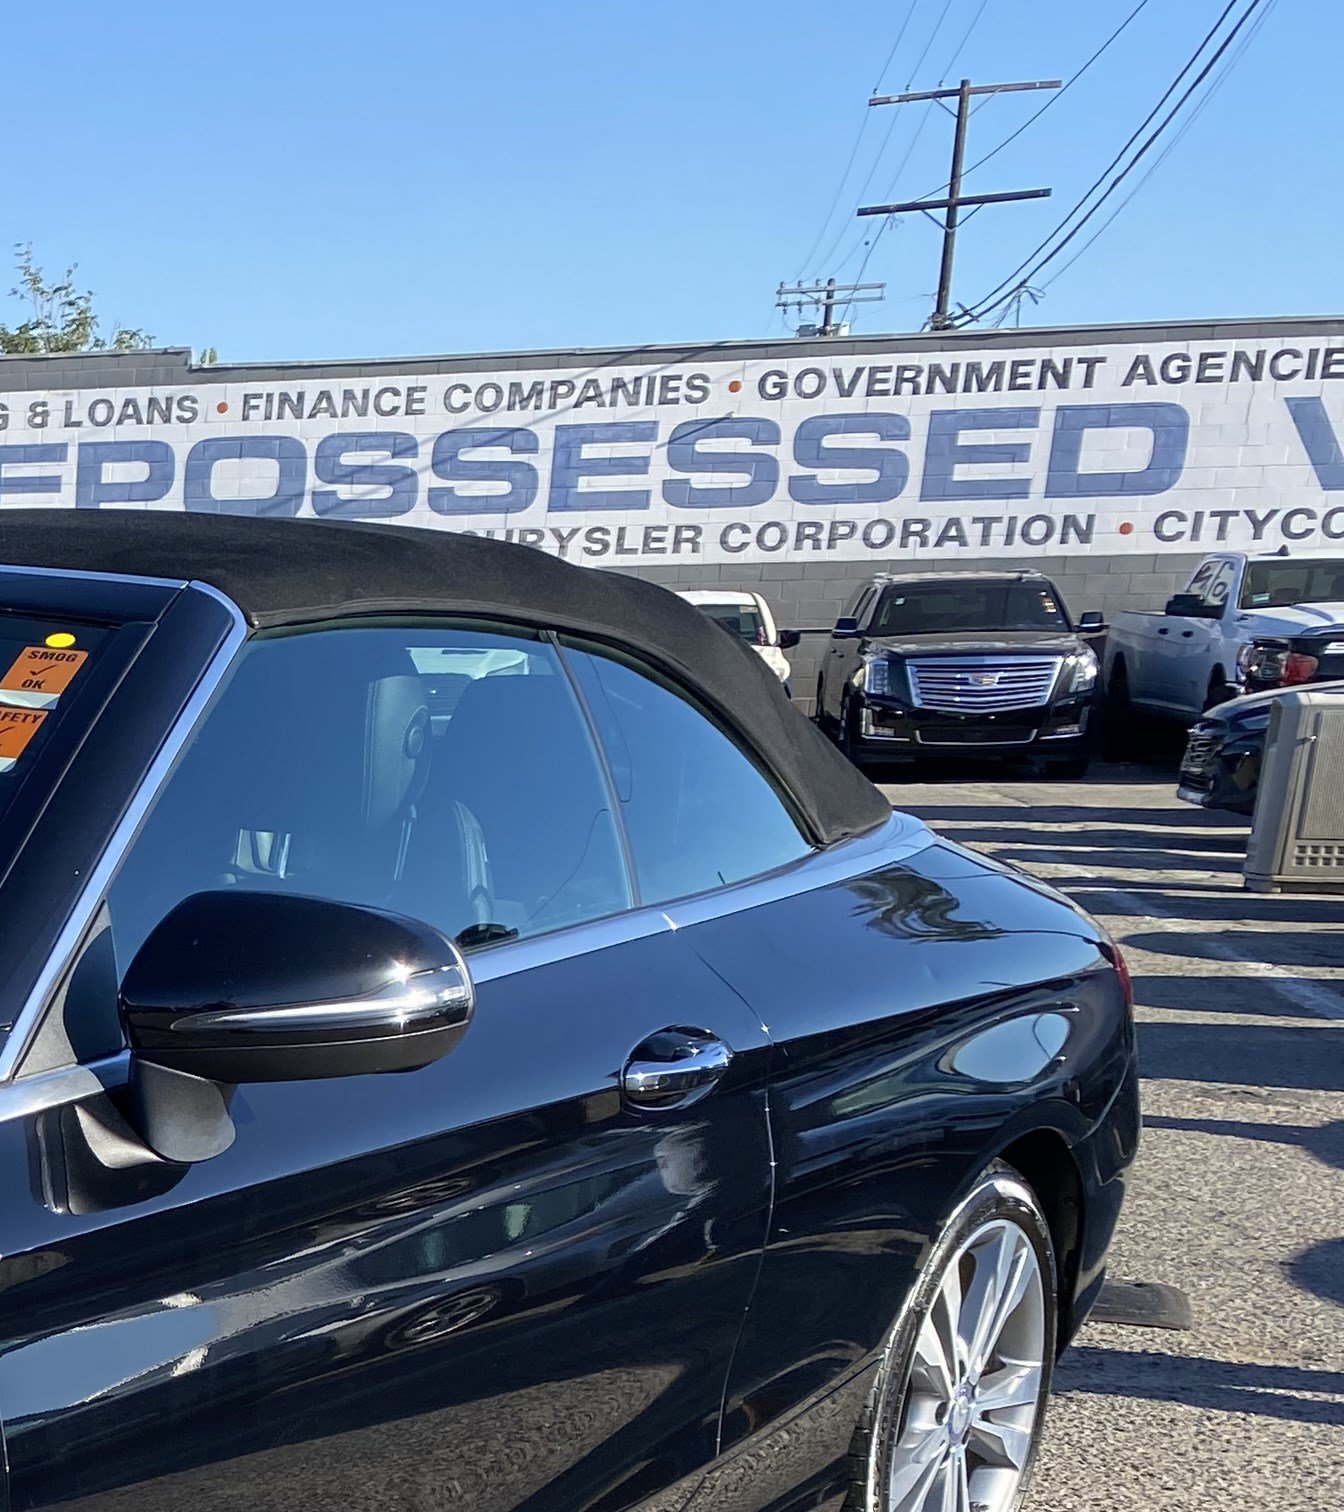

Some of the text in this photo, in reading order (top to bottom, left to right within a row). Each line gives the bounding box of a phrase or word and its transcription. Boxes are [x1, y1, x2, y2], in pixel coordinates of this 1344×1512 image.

[27, 400, 50, 430] &
[64, 394, 199, 429] LOANS
[241, 384, 428, 421] FINANCE
[443, 372, 711, 415] COMPANIES
[757, 355, 1107, 401] GOVERNMENT
[462, 524, 703, 557] RYSLER
[719, 513, 1096, 554] CORPORATION
[27, 650, 79, 662] SMOG
[20, 678, 46, 690] OK
